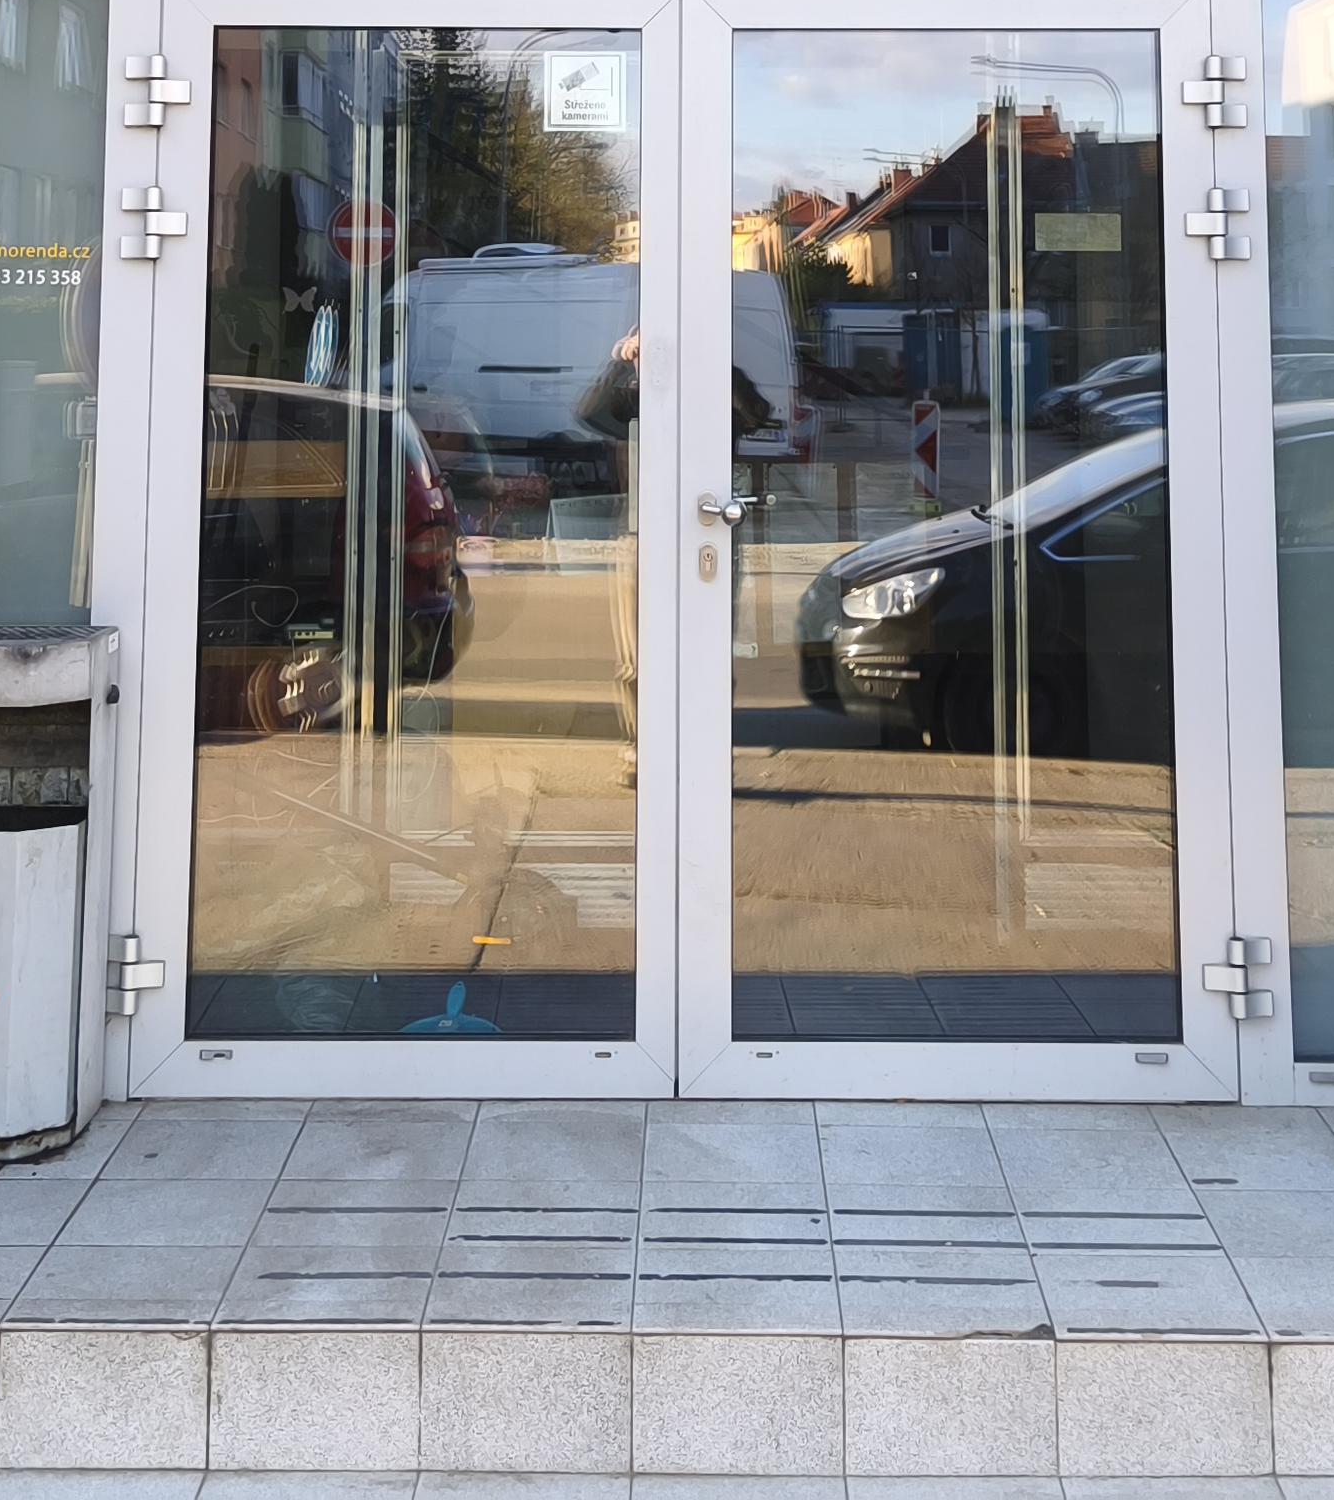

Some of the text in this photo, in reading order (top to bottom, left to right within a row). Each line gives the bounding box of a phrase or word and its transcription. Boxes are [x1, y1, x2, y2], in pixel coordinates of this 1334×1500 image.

[564, 99, 606, 110] Střeženo
[561, 110, 609, 121] kamerami
[15, 269, 46, 285] 215
[50, 269, 82, 286] 358
